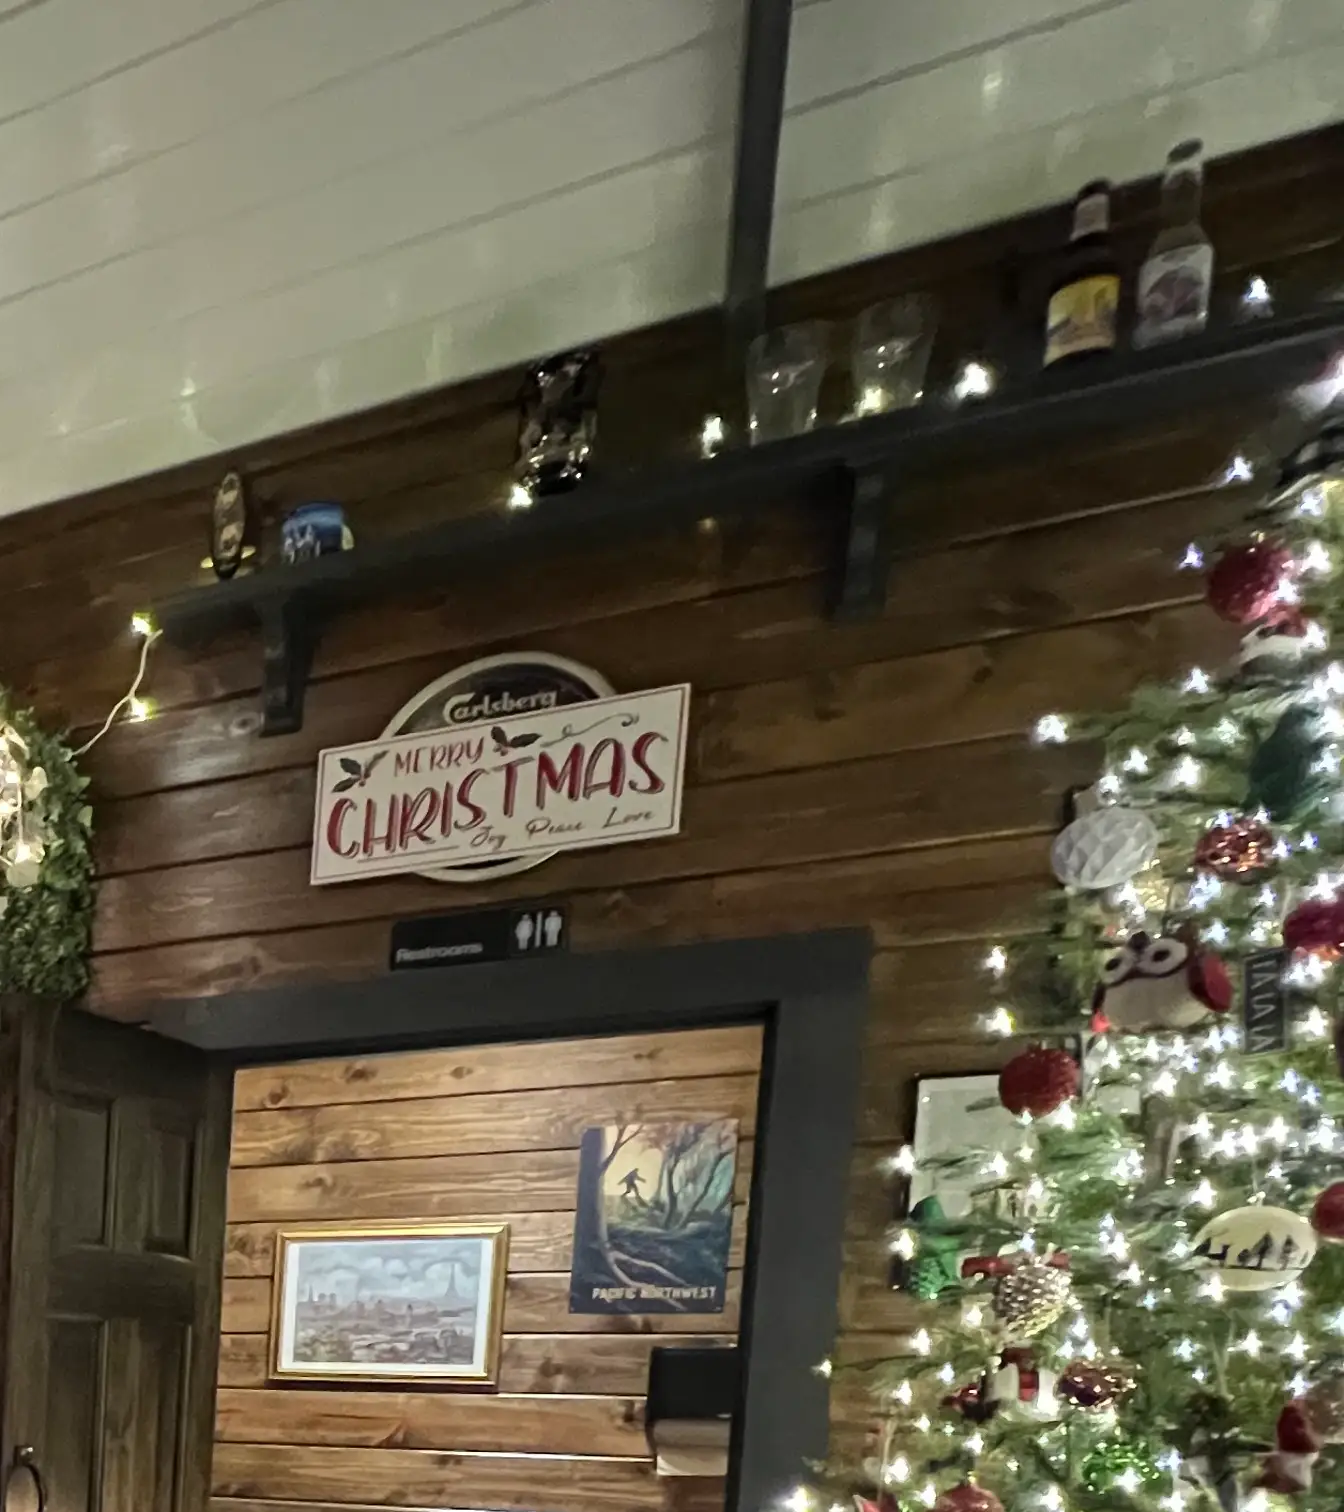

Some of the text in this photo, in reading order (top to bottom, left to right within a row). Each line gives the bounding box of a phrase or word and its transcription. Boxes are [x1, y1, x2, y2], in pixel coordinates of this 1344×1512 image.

[443, 690, 558, 725] Carlsberg
[395, 737, 485, 778] MERRY
[326, 731, 668, 860] CHRISTMAS
[470, 806, 654, 849] Joy Peace Love
[396, 942, 484, 963] Restrooms
[591, 1285, 717, 1301] PACIFIC NORTHWEST
